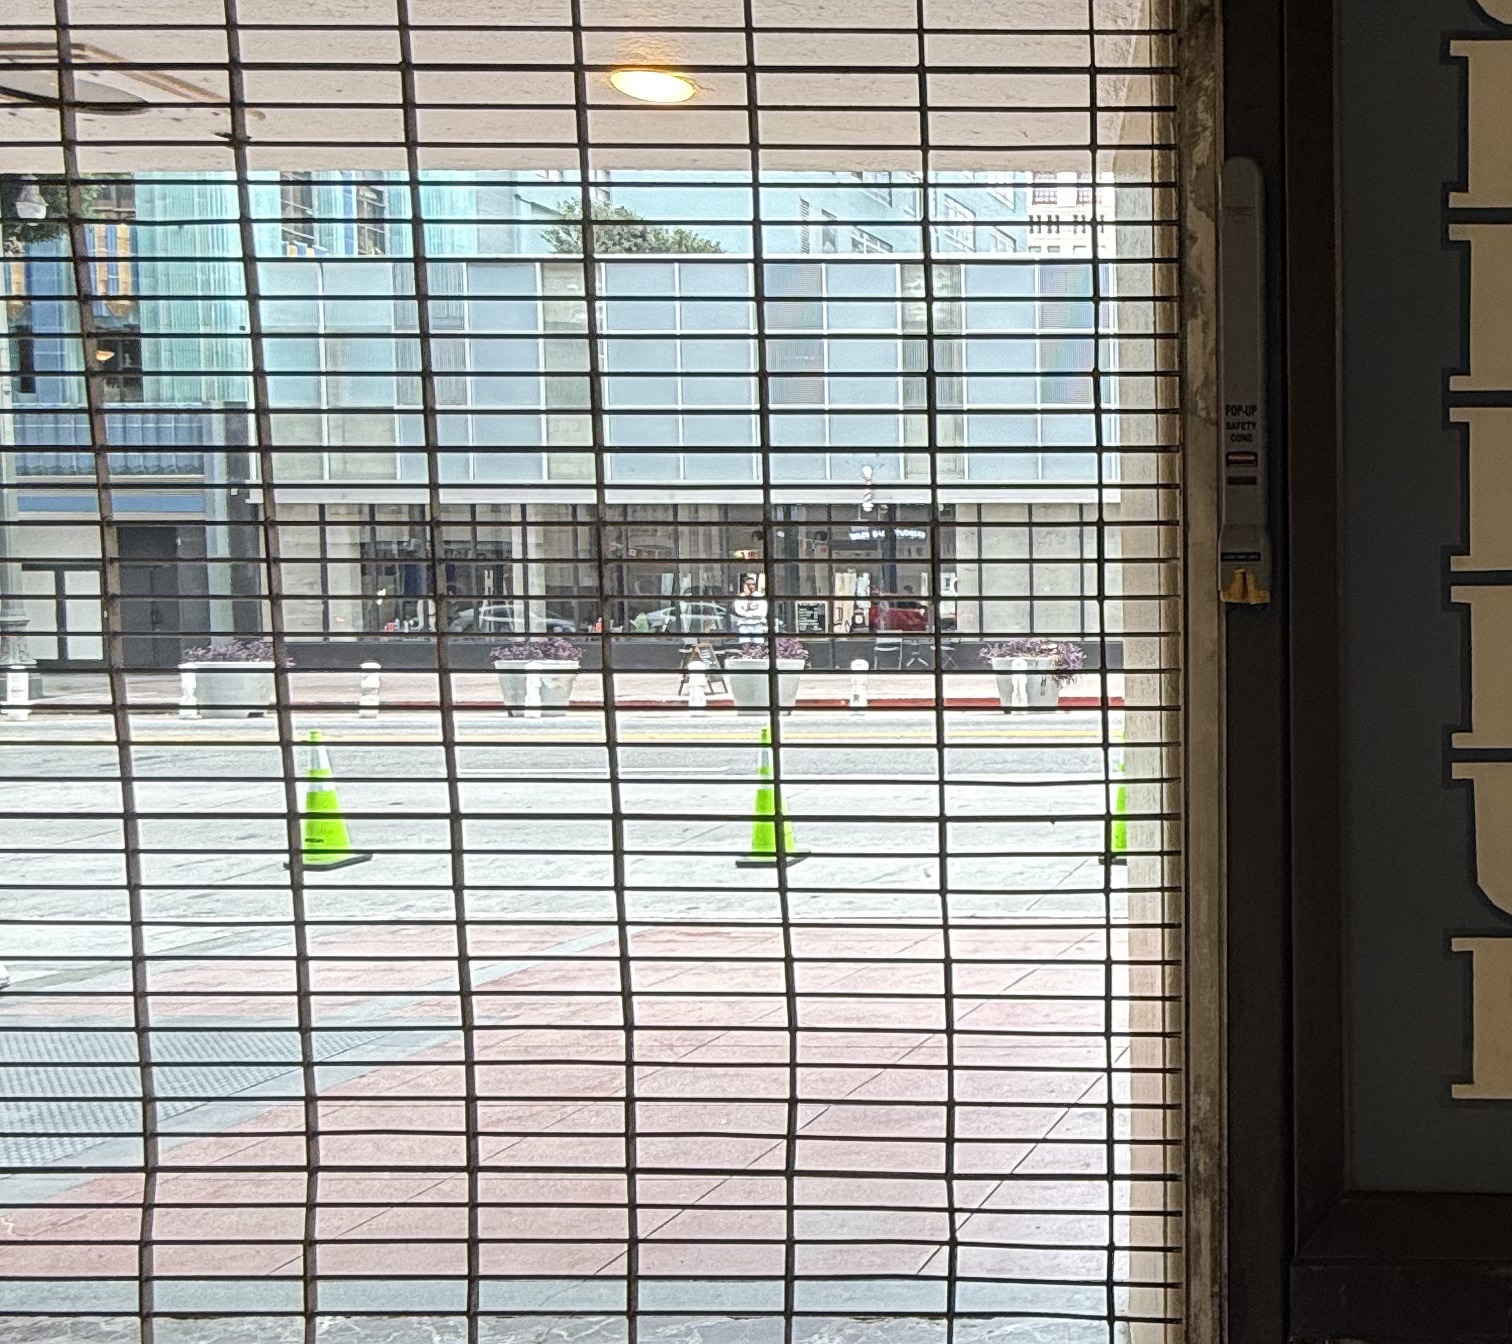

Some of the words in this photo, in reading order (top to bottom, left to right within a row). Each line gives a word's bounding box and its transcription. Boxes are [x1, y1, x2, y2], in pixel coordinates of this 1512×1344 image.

[1225, 404, 1258, 417] POP-UP
[1226, 421, 1257, 431] SAFETY
[1230, 433, 1254, 443] CONE
